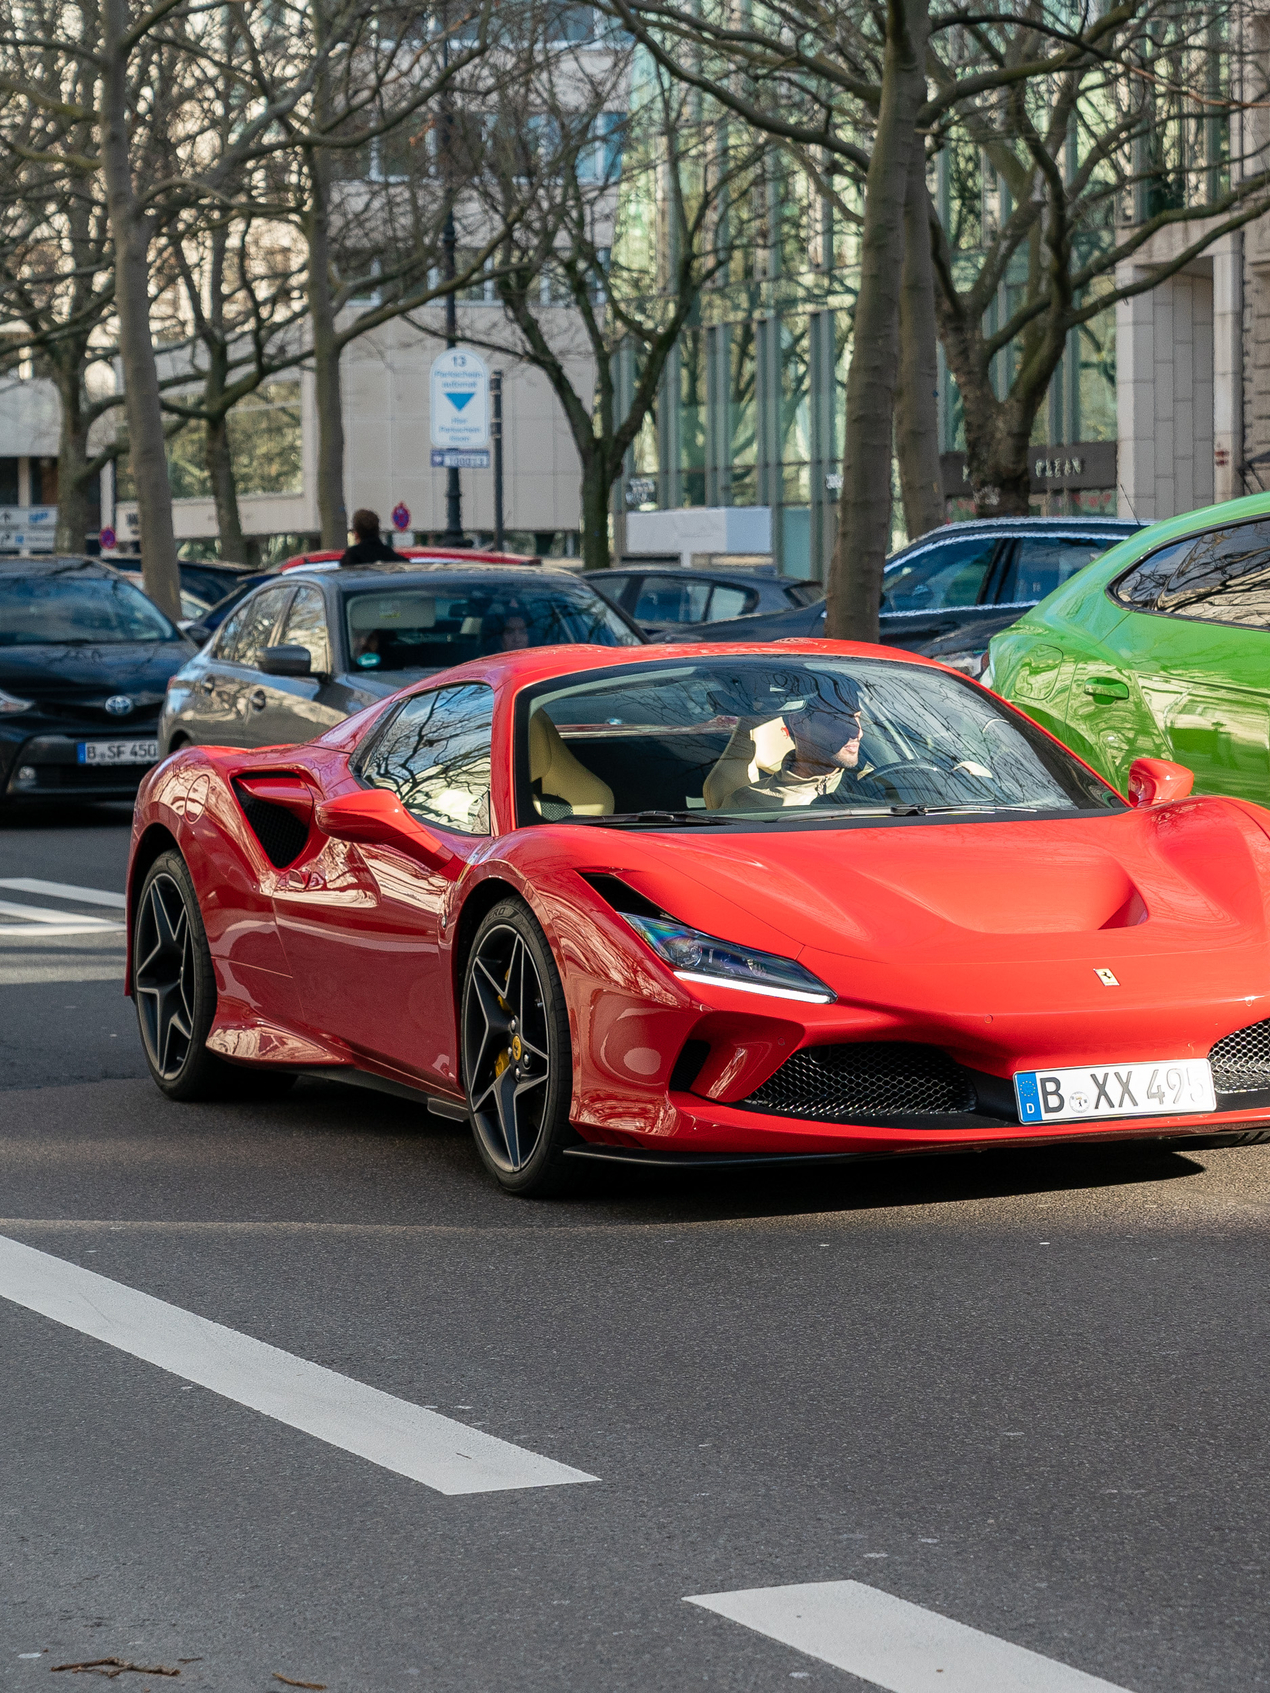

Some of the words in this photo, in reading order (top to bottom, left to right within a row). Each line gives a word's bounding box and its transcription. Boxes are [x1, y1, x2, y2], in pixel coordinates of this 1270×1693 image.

[453, 355, 467, 368] 13
[86, 746, 97, 760] B
[107, 744, 126, 760] SF
[129, 743, 157, 758] 450
[1026, 1103, 1035, 1114] D
[1039, 1076, 1065, 1114] B
[1090, 1070, 1139, 1110] XX
